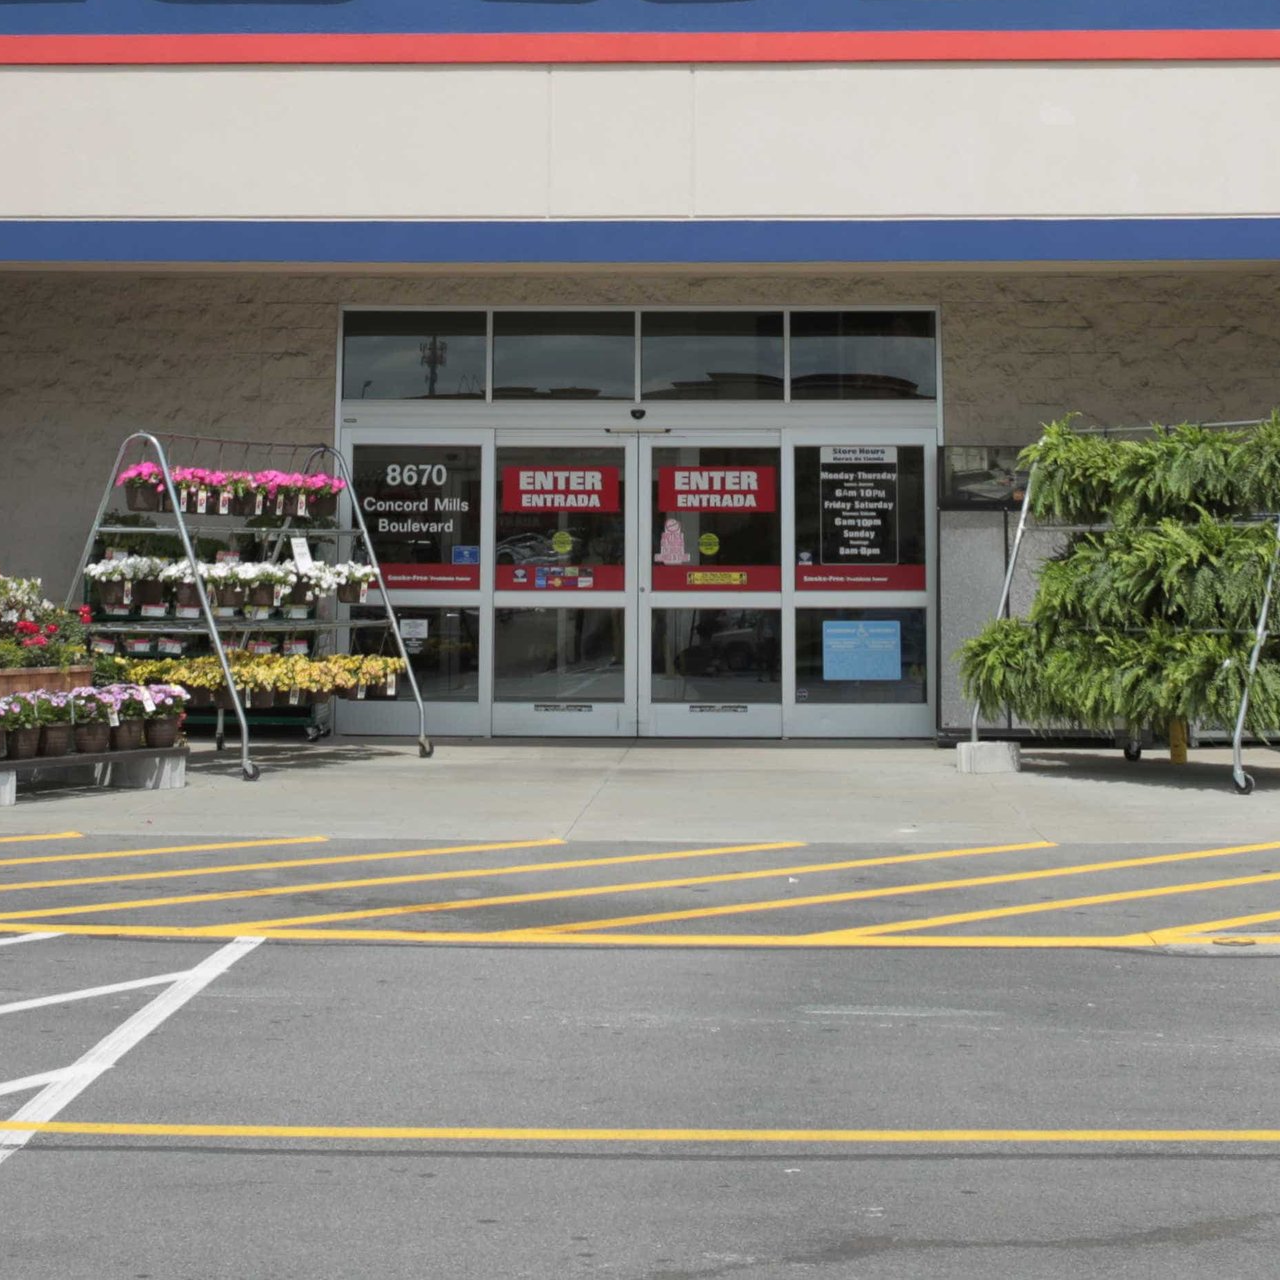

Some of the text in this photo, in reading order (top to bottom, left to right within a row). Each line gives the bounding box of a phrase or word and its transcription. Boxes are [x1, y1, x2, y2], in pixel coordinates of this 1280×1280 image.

[832, 447, 886, 455] Store Hours
[386, 464, 448, 486] 8670
[519, 471, 603, 490] ENTER
[674, 471, 758, 490] ENTER
[363, 497, 469, 511] Concord Mills
[521, 494, 600, 507] ENTRADA
[677, 494, 757, 507] ENTRADA
[378, 518, 454, 532] Boulevard
[843, 530, 875, 539] Sunday
